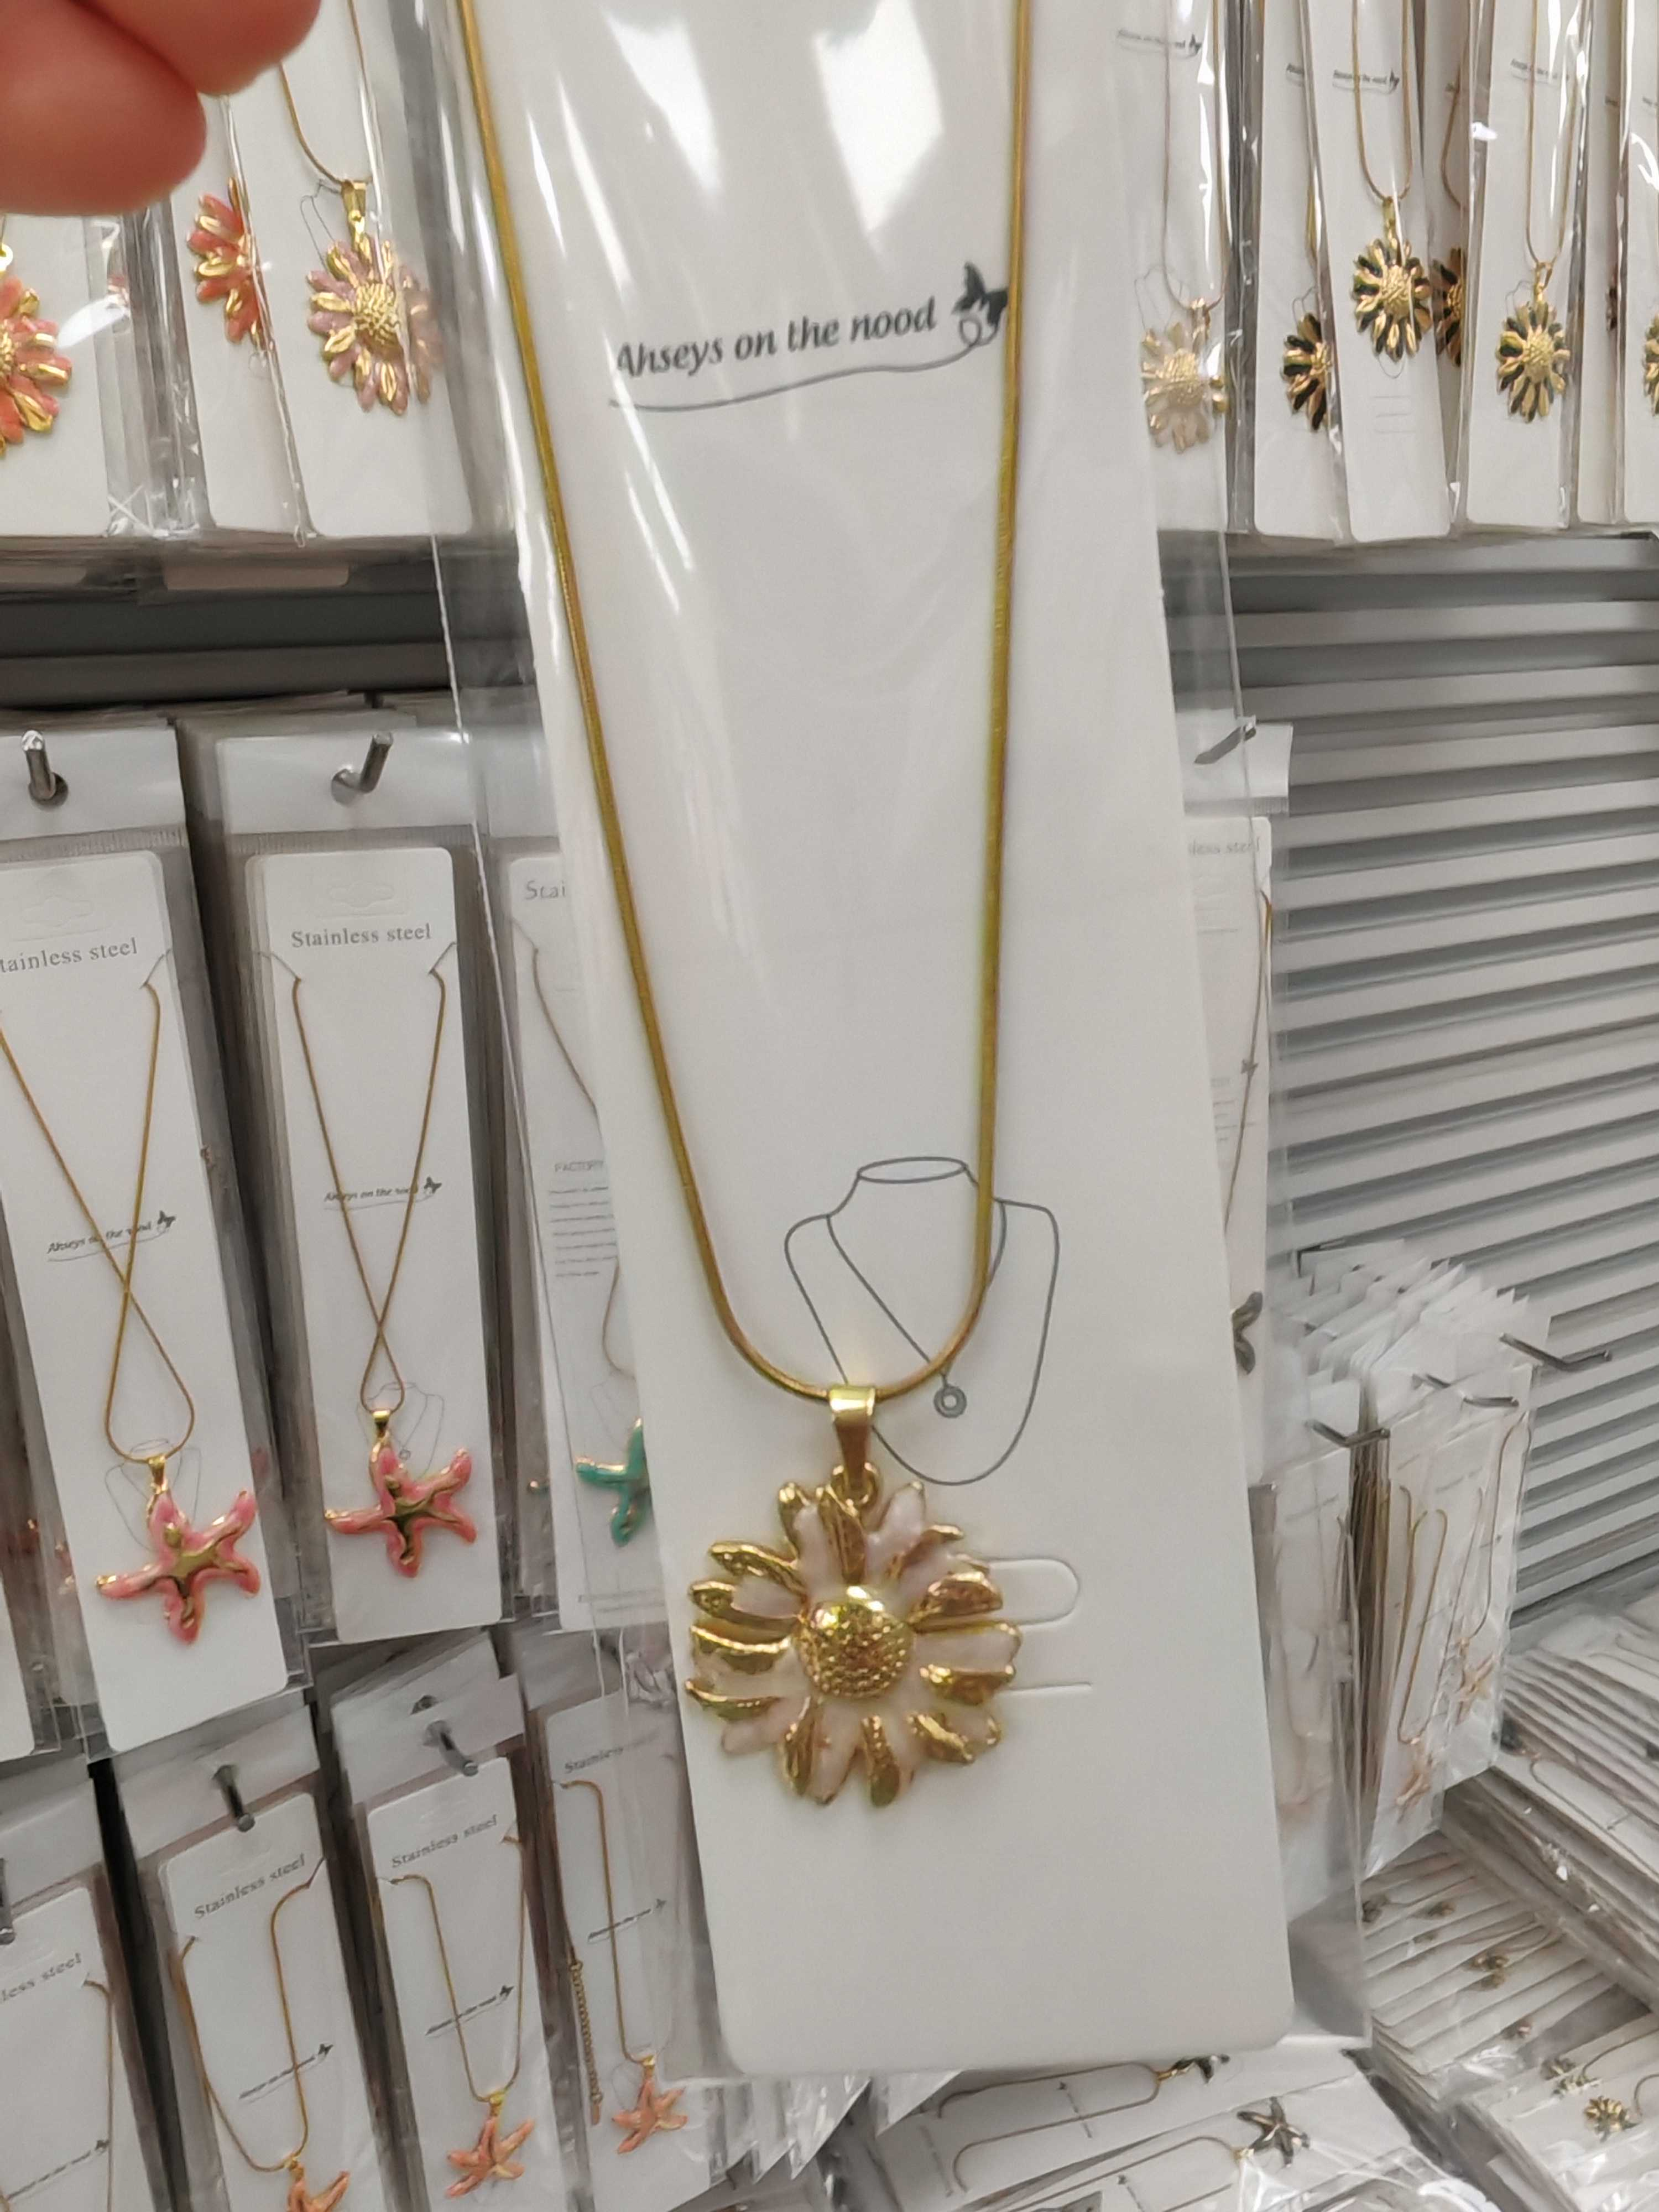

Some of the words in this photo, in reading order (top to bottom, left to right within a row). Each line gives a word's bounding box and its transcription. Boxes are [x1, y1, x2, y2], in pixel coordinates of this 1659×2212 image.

[734, 330, 777, 361] on
[787, 315, 839, 352] the
[291, 927, 379, 948] Stainless
[387, 922, 431, 942] steel
[89, 937, 138, 961] steel
